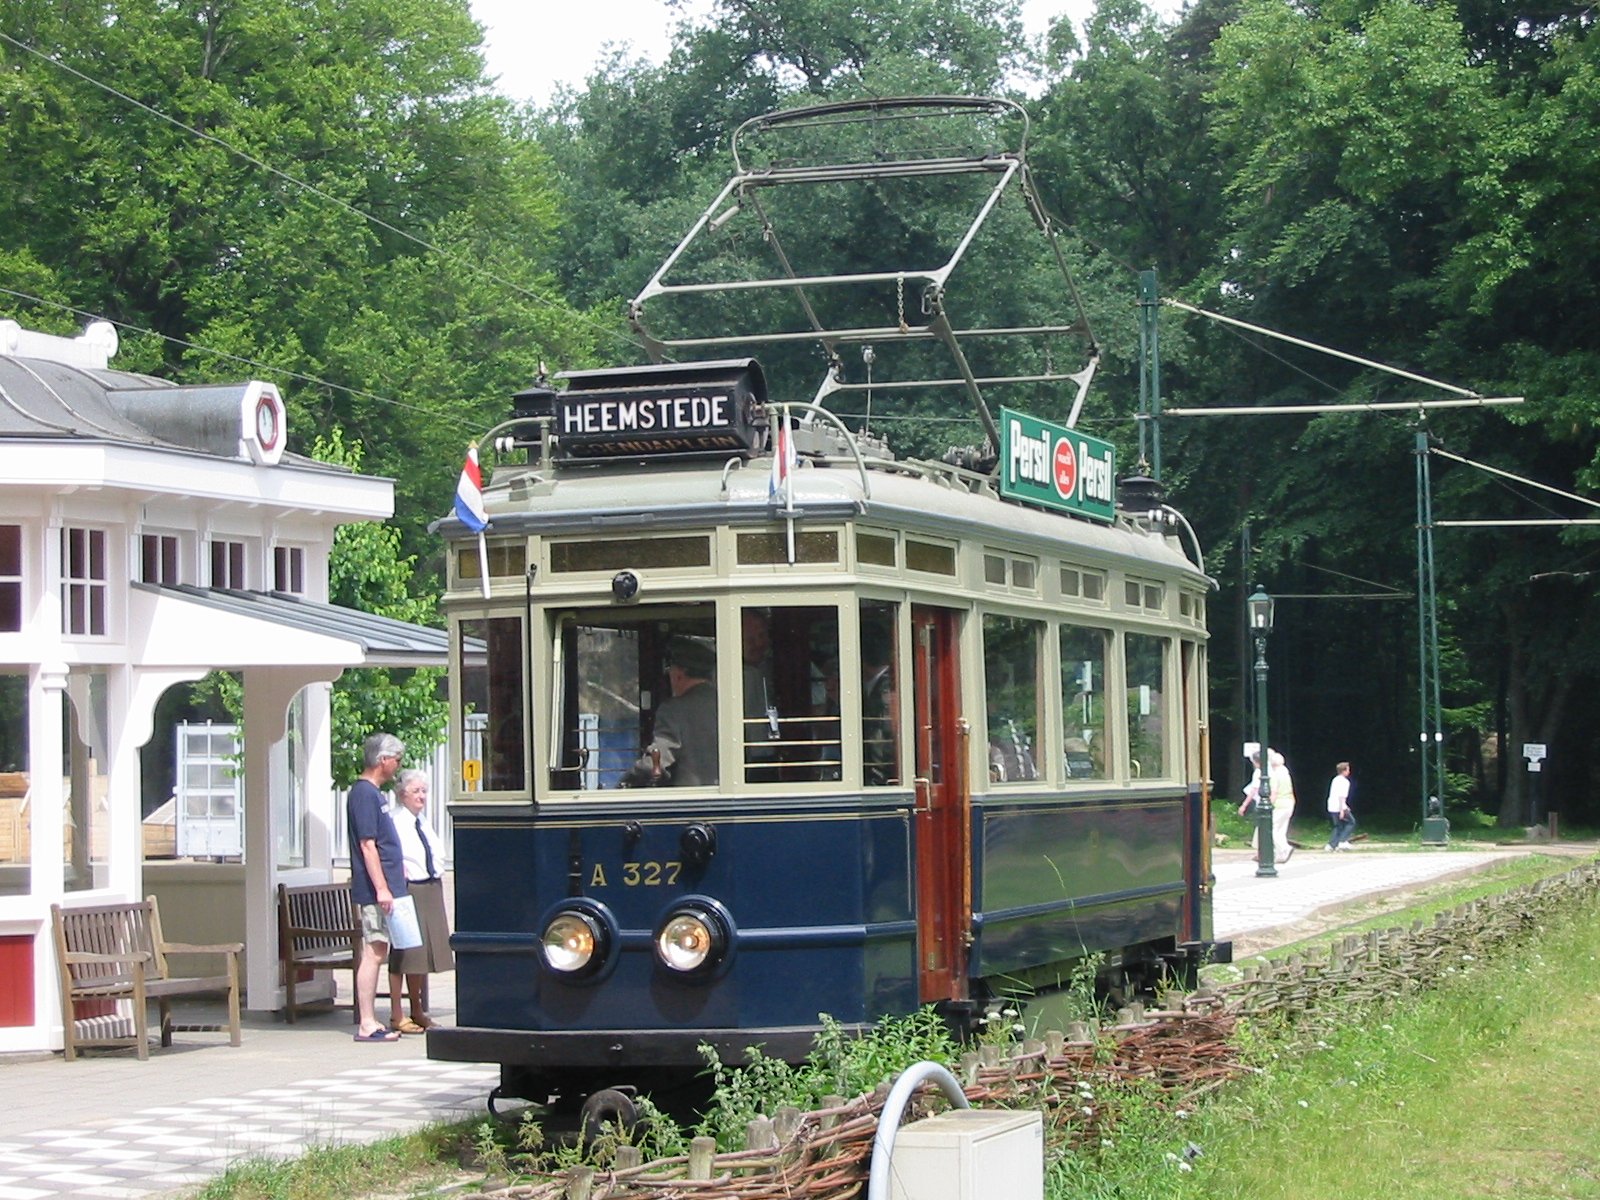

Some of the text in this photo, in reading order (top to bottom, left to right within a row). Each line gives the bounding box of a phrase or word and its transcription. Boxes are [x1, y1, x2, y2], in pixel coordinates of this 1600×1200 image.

[563, 396, 729, 433] HEEMSTEDE
[1010, 419, 1112, 502] Persil Persil
[467, 763, 474, 778] 1
[590, 861, 682, 887] A 327
